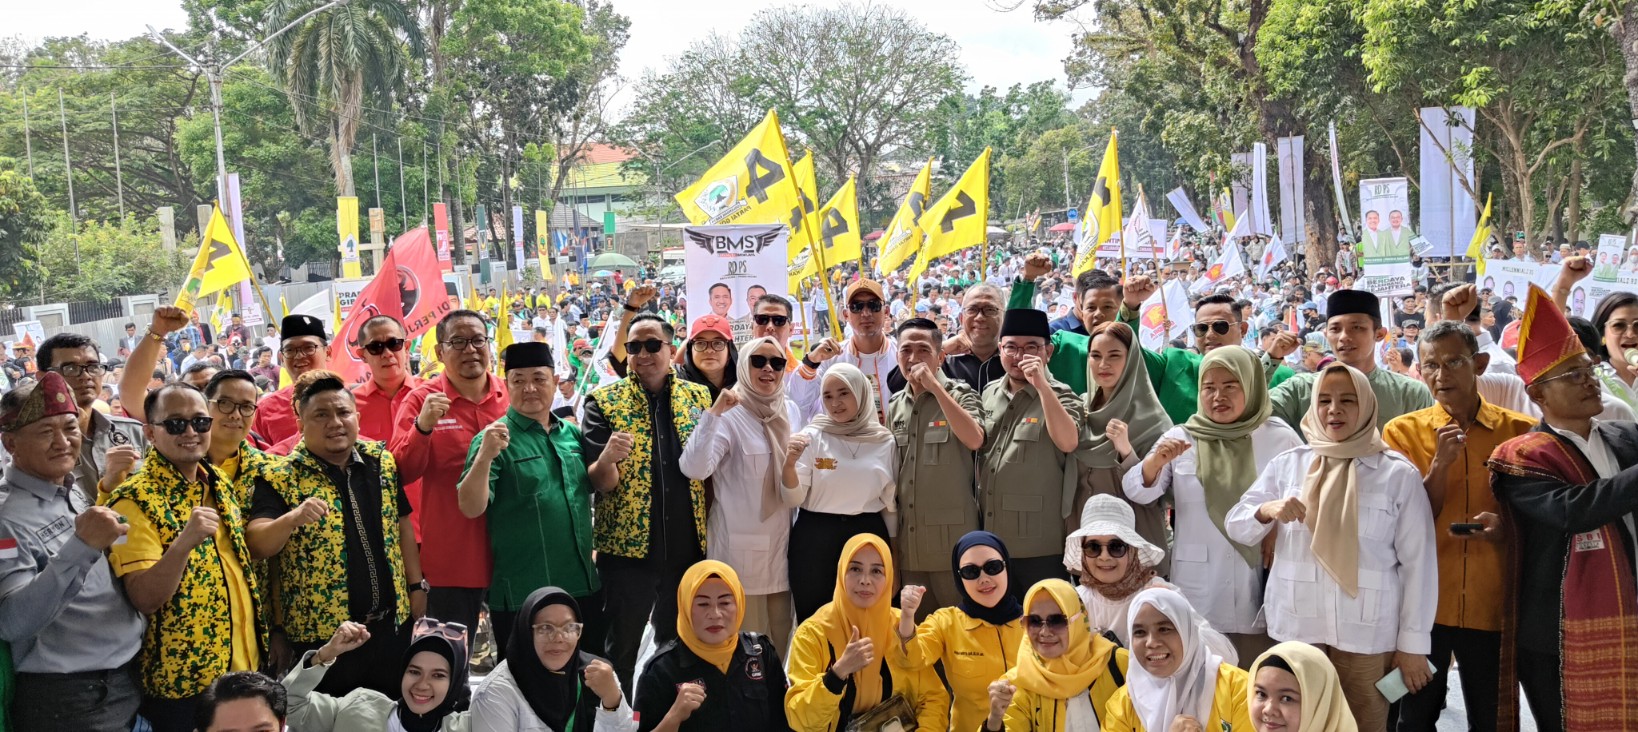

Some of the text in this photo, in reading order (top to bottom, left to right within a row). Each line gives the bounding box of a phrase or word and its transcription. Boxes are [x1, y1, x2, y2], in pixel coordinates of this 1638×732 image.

[717, 235, 755, 252] BMS
[738, 260, 747, 273] PS
[1370, 283, 1411, 292] EJAHTERA
